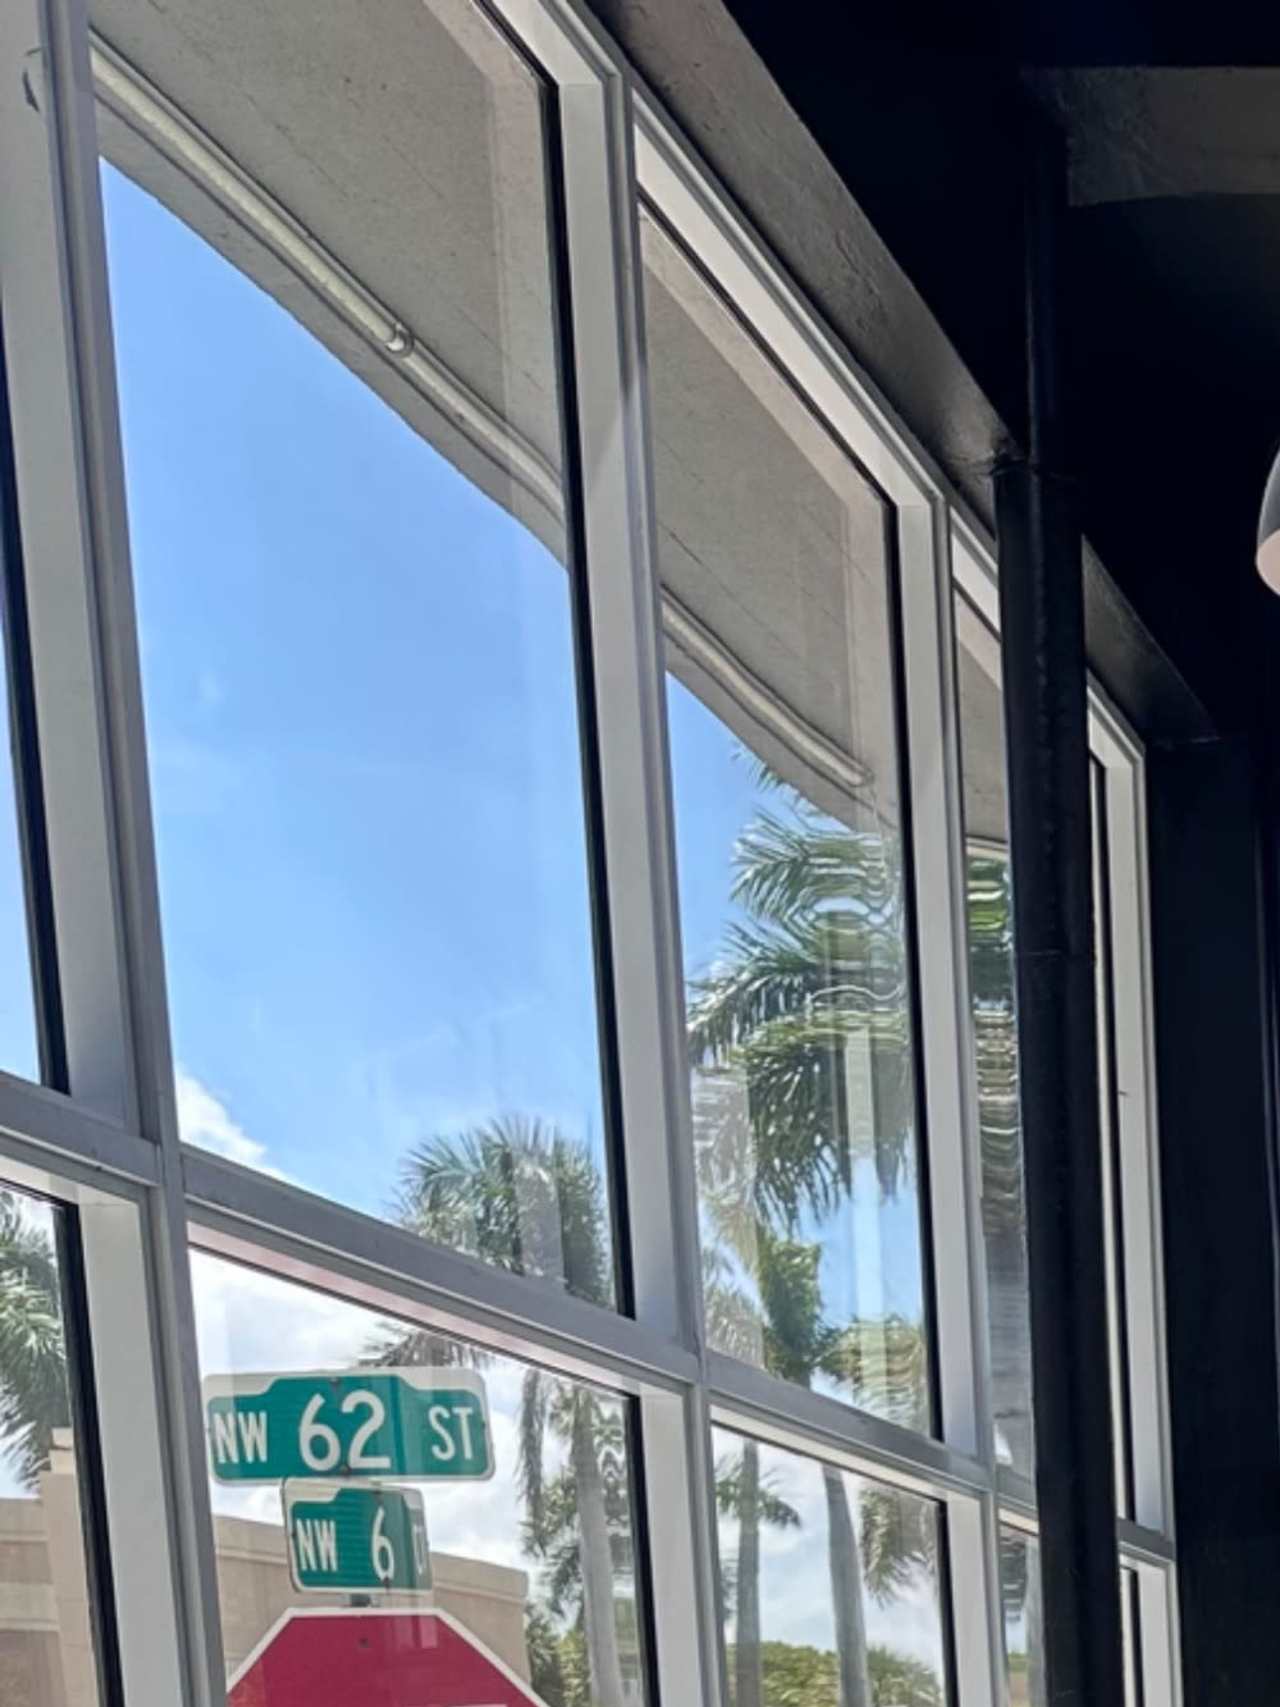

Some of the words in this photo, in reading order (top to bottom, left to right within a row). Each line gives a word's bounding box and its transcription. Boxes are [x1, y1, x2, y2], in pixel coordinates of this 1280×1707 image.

[213, 1411, 268, 1464] NW
[299, 1389, 391, 1471] 62
[428, 1404, 474, 1461] ST
[296, 1518, 338, 1573] NW
[372, 1506, 395, 1581] 6
